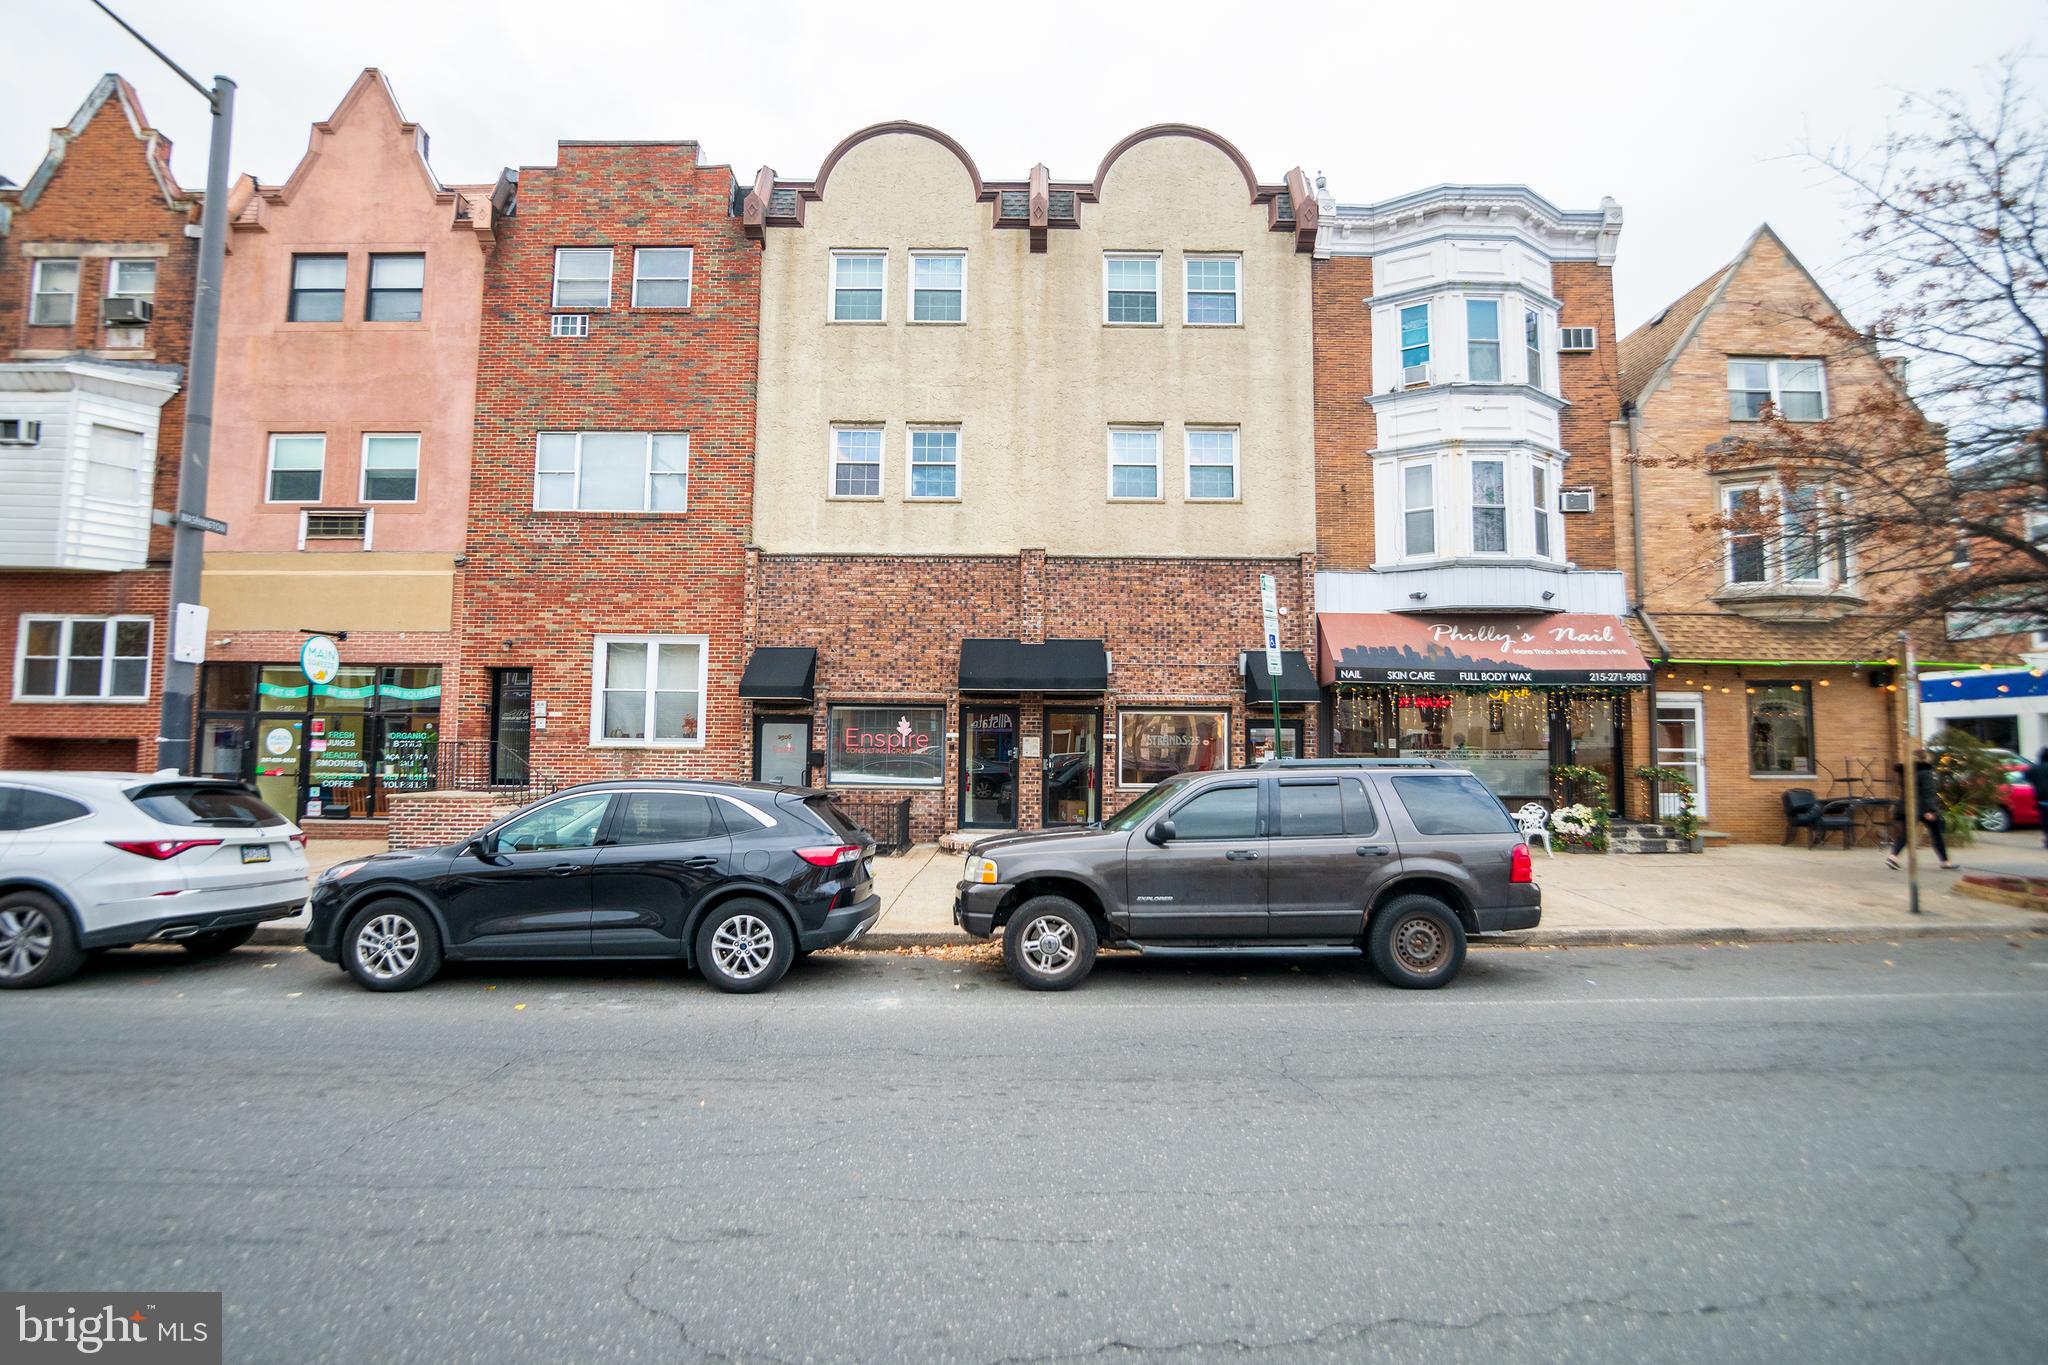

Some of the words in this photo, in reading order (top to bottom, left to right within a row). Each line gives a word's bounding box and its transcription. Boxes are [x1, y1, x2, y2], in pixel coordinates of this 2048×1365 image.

[1427, 624, 1535, 653] Philly's
[1549, 626, 1615, 642] Nail
[308, 648, 336, 659] MAIN
[1341, 670, 1363, 679] NAIL
[1387, 671, 1408, 680] SKIN
[1409, 671, 1436, 681] CARE
[1459, 672, 1480, 681] FULL
[1481, 672, 1507, 681] BODY
[1508, 672, 1532, 681] WAX
[1589, 672, 1647, 682] 215-271-9831
[328, 731, 355, 739] FRESH
[390, 732, 427, 740] ORGANIC
[845, 722, 929, 753] Enspire
[327, 739, 356, 747] JUICES
[322, 780, 354, 788] COFFEE
